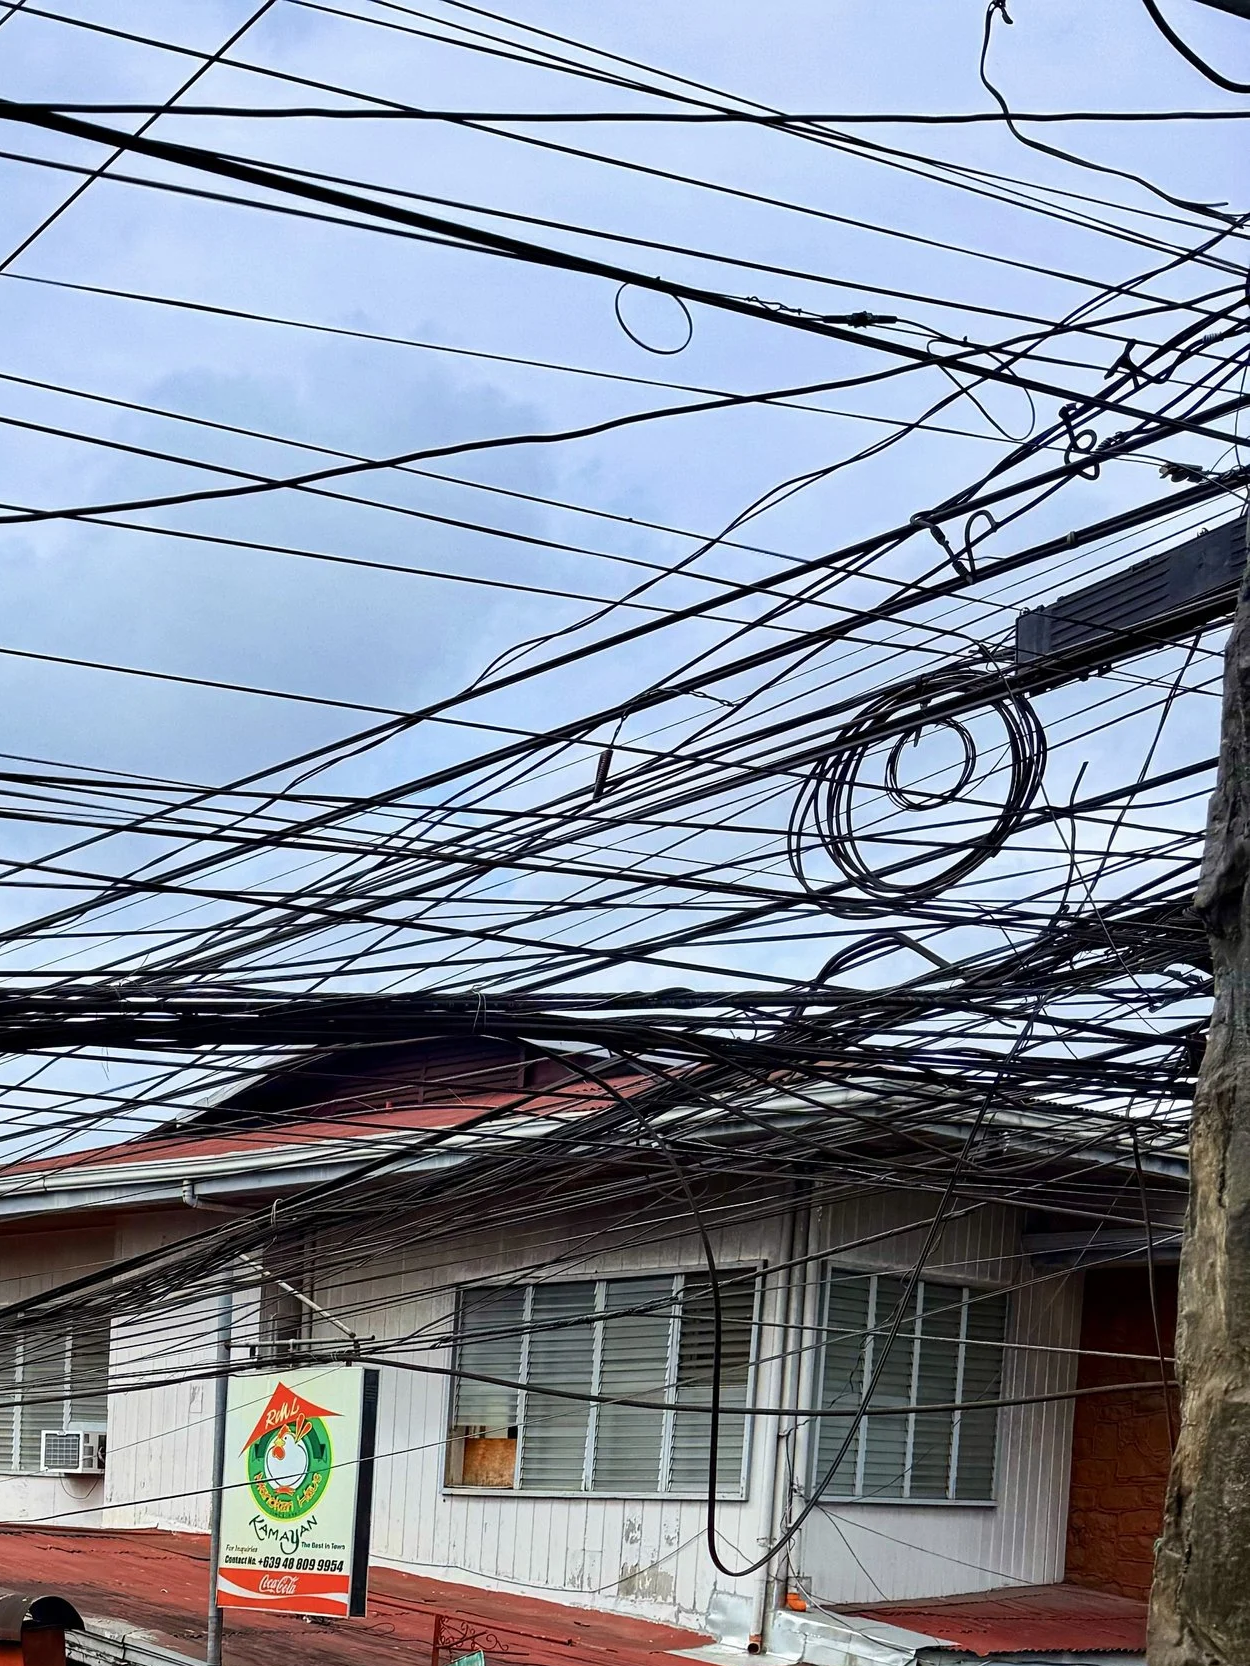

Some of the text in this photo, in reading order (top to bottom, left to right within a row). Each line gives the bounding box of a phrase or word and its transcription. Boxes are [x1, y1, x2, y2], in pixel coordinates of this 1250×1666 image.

[265, 1397, 299, 1429] RML
[249, 1515, 318, 1555] KAMAYAN
[225, 1555, 248, 1564] Contact
[258, 1556, 281, 1569] +639
[281, 1558, 295, 1570] 48
[296, 1558, 316, 1571] 809
[317, 1559, 344, 1573] 9954
[259, 1574, 300, 1595] Coca-Cola
